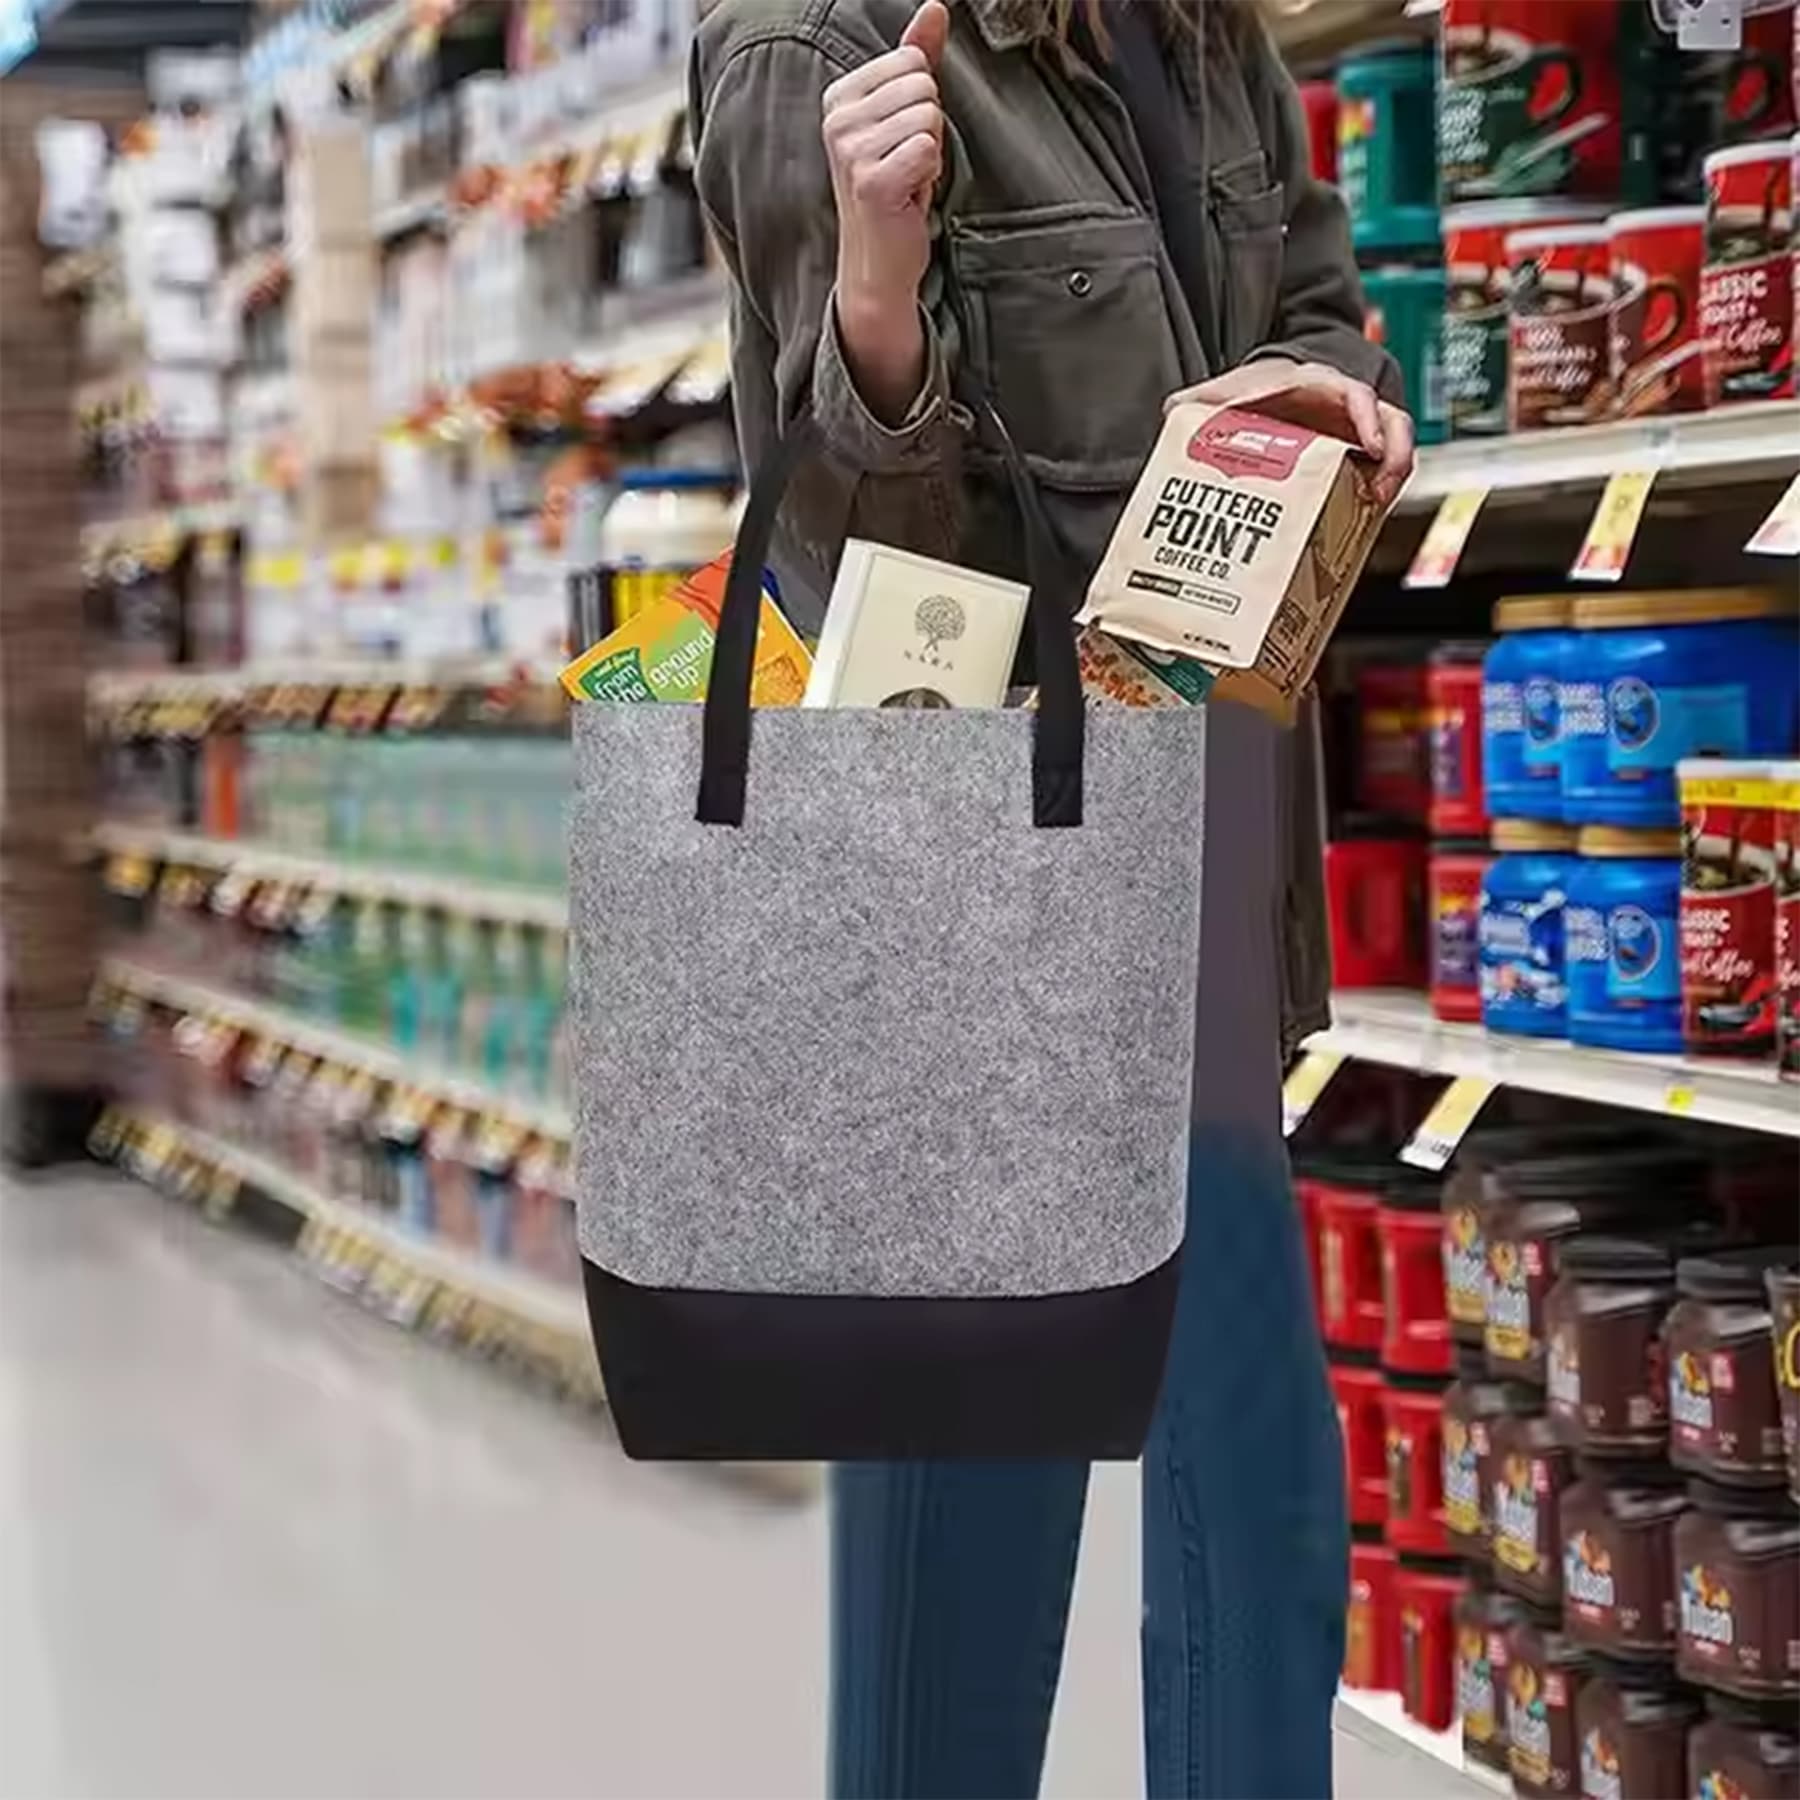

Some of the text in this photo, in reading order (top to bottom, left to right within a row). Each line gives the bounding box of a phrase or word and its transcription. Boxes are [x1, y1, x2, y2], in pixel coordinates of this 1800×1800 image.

[1160, 476, 1284, 529] CUTTERS
[1143, 502, 1272, 565] POINT
[1153, 546, 1207, 574] COFFEE
[649, 627, 714, 689] ground
[672, 662, 700, 689] up
[594, 664, 640, 700] from
